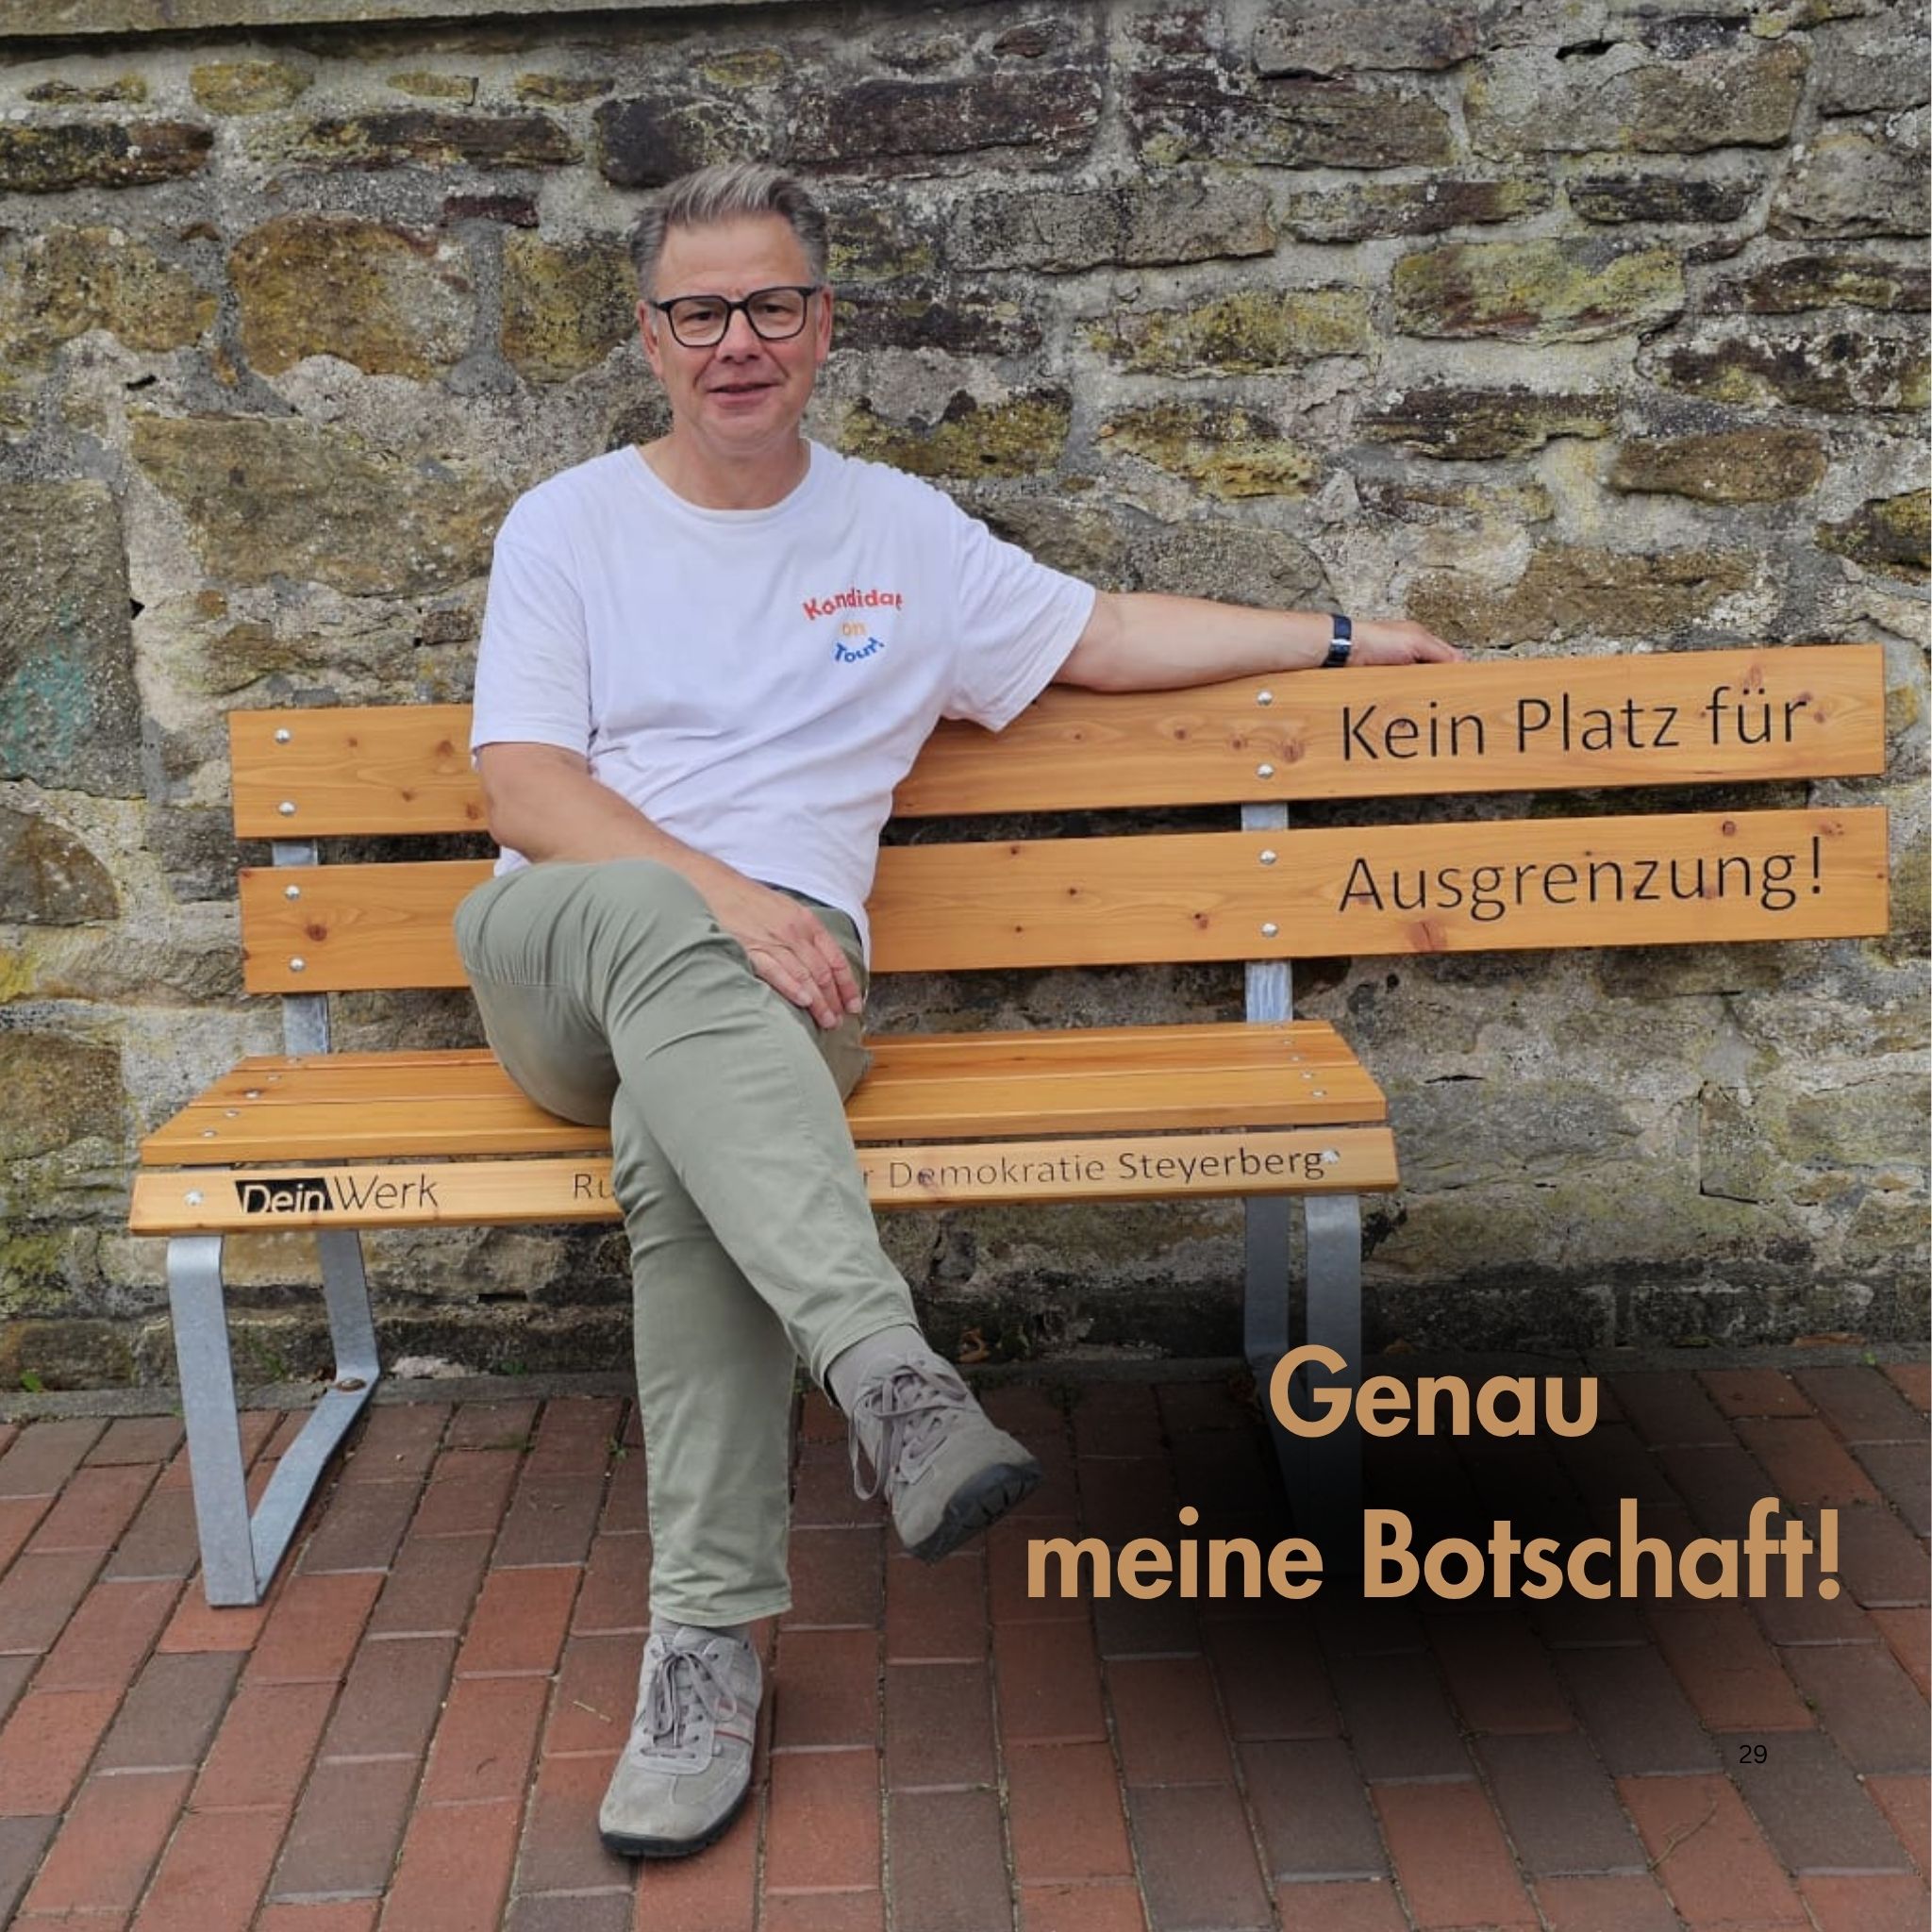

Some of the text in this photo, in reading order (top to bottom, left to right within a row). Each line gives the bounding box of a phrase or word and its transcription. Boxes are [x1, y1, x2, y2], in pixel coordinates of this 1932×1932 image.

[803, 587, 902, 620] Kandidat
[841, 623, 865, 636] on
[1342, 686, 1807, 760] Kein Platz für
[1339, 836, 1822, 921] Ausgrenzung!
[889, 1152, 1105, 1189] Demokratie
[1119, 1145, 1324, 1184] Steyerberg
